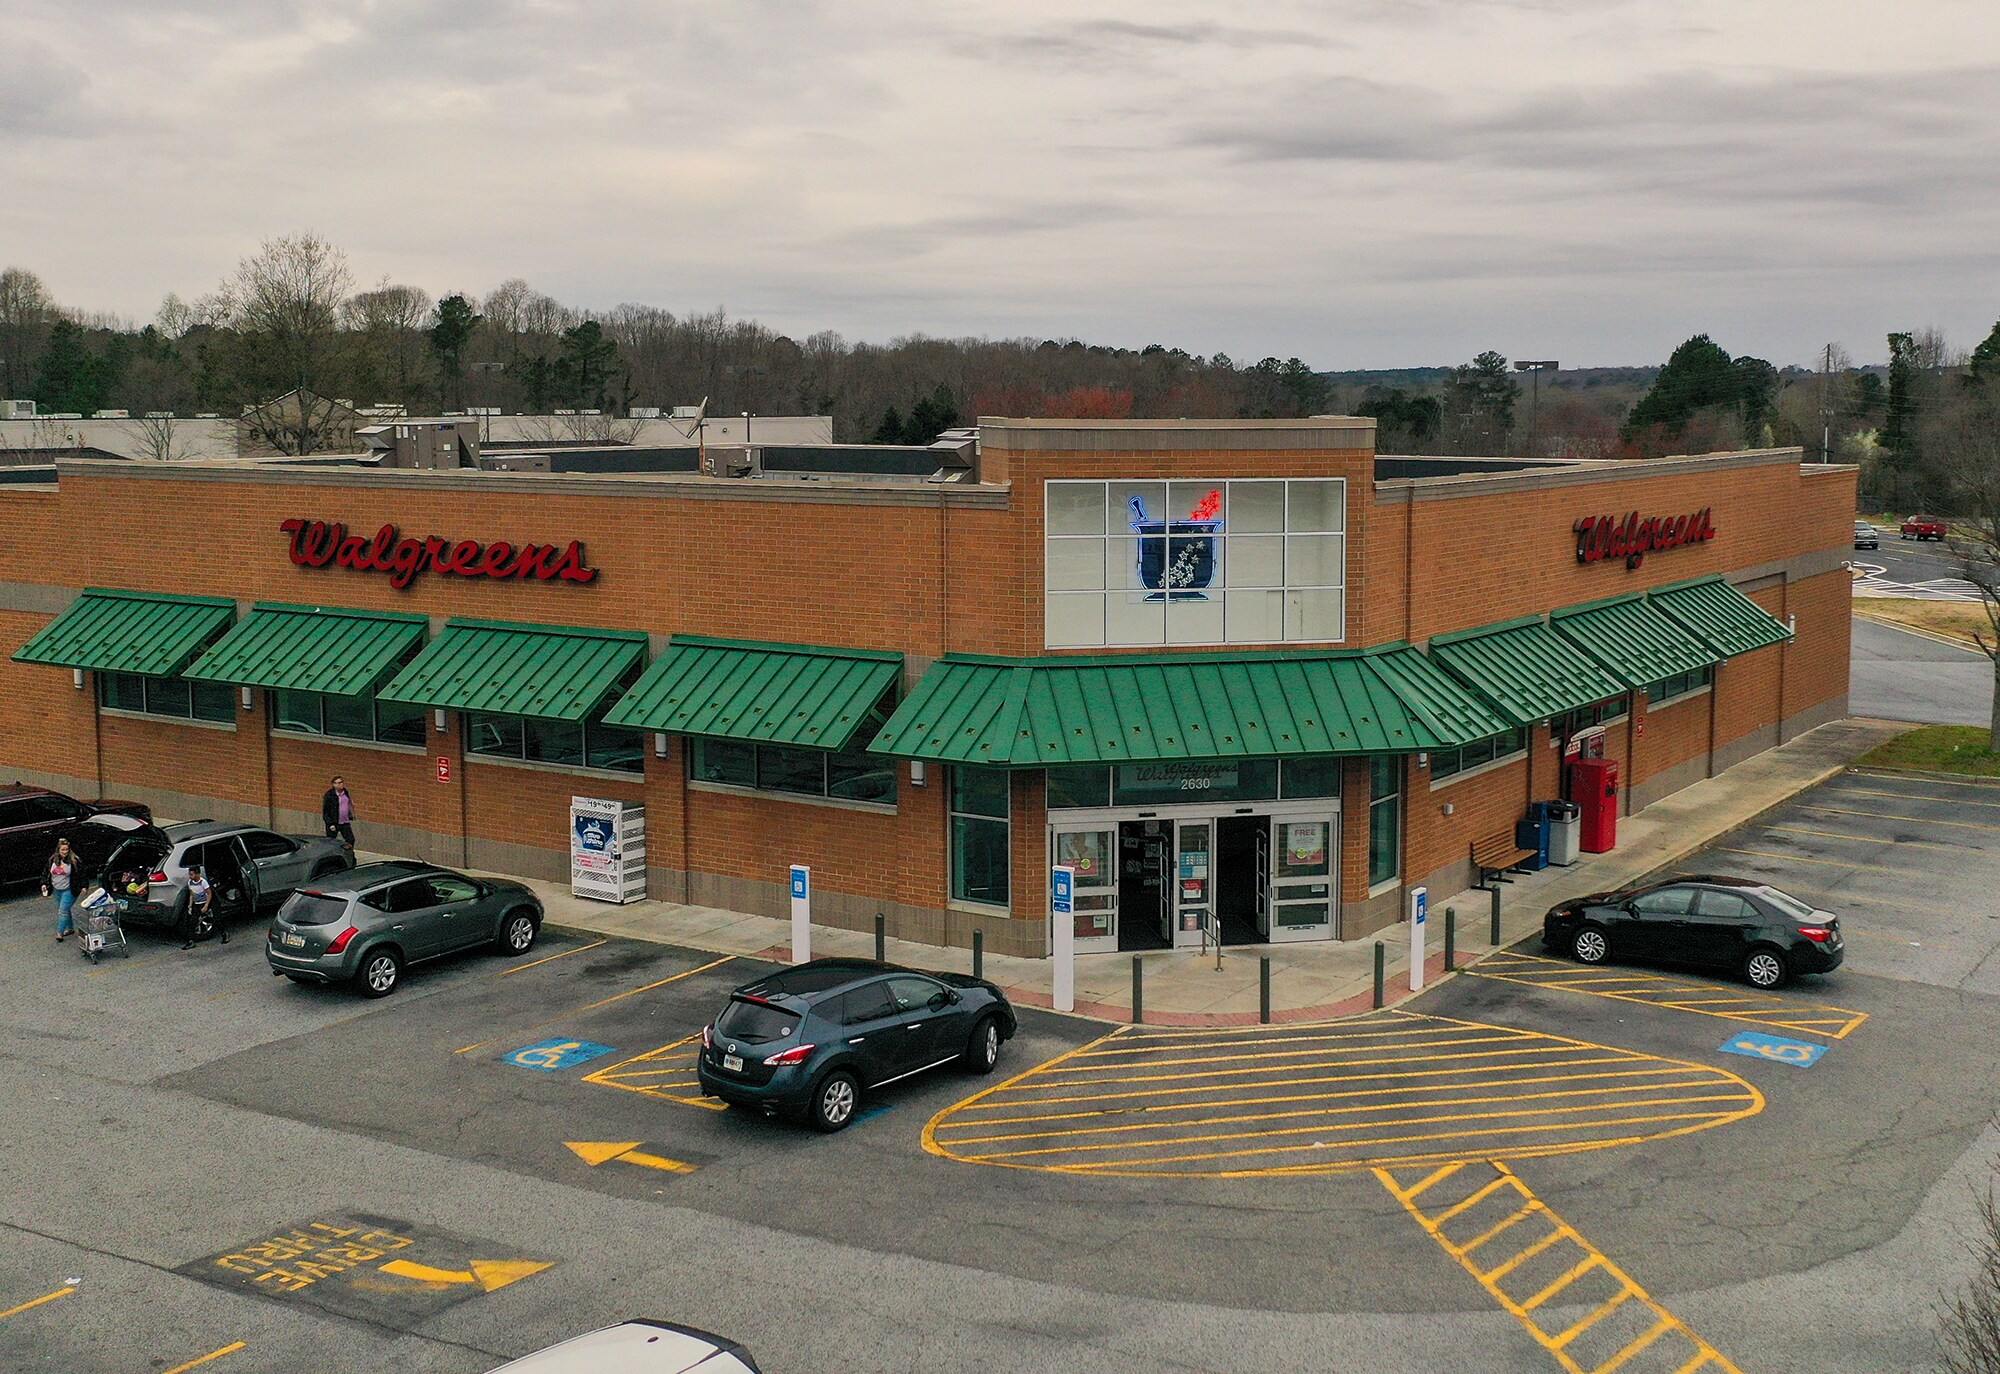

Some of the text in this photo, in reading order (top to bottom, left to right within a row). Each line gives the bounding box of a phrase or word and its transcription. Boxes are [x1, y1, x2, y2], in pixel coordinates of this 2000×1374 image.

[280, 518, 595, 589] Walgreens
[1574, 508, 1716, 570] Walgreens
[1181, 778, 1211, 790] 2630
[1294, 829, 1316, 837] FREE
[215, 1222, 360, 1274] THRU
[254, 1230, 415, 1292] DRIVE
